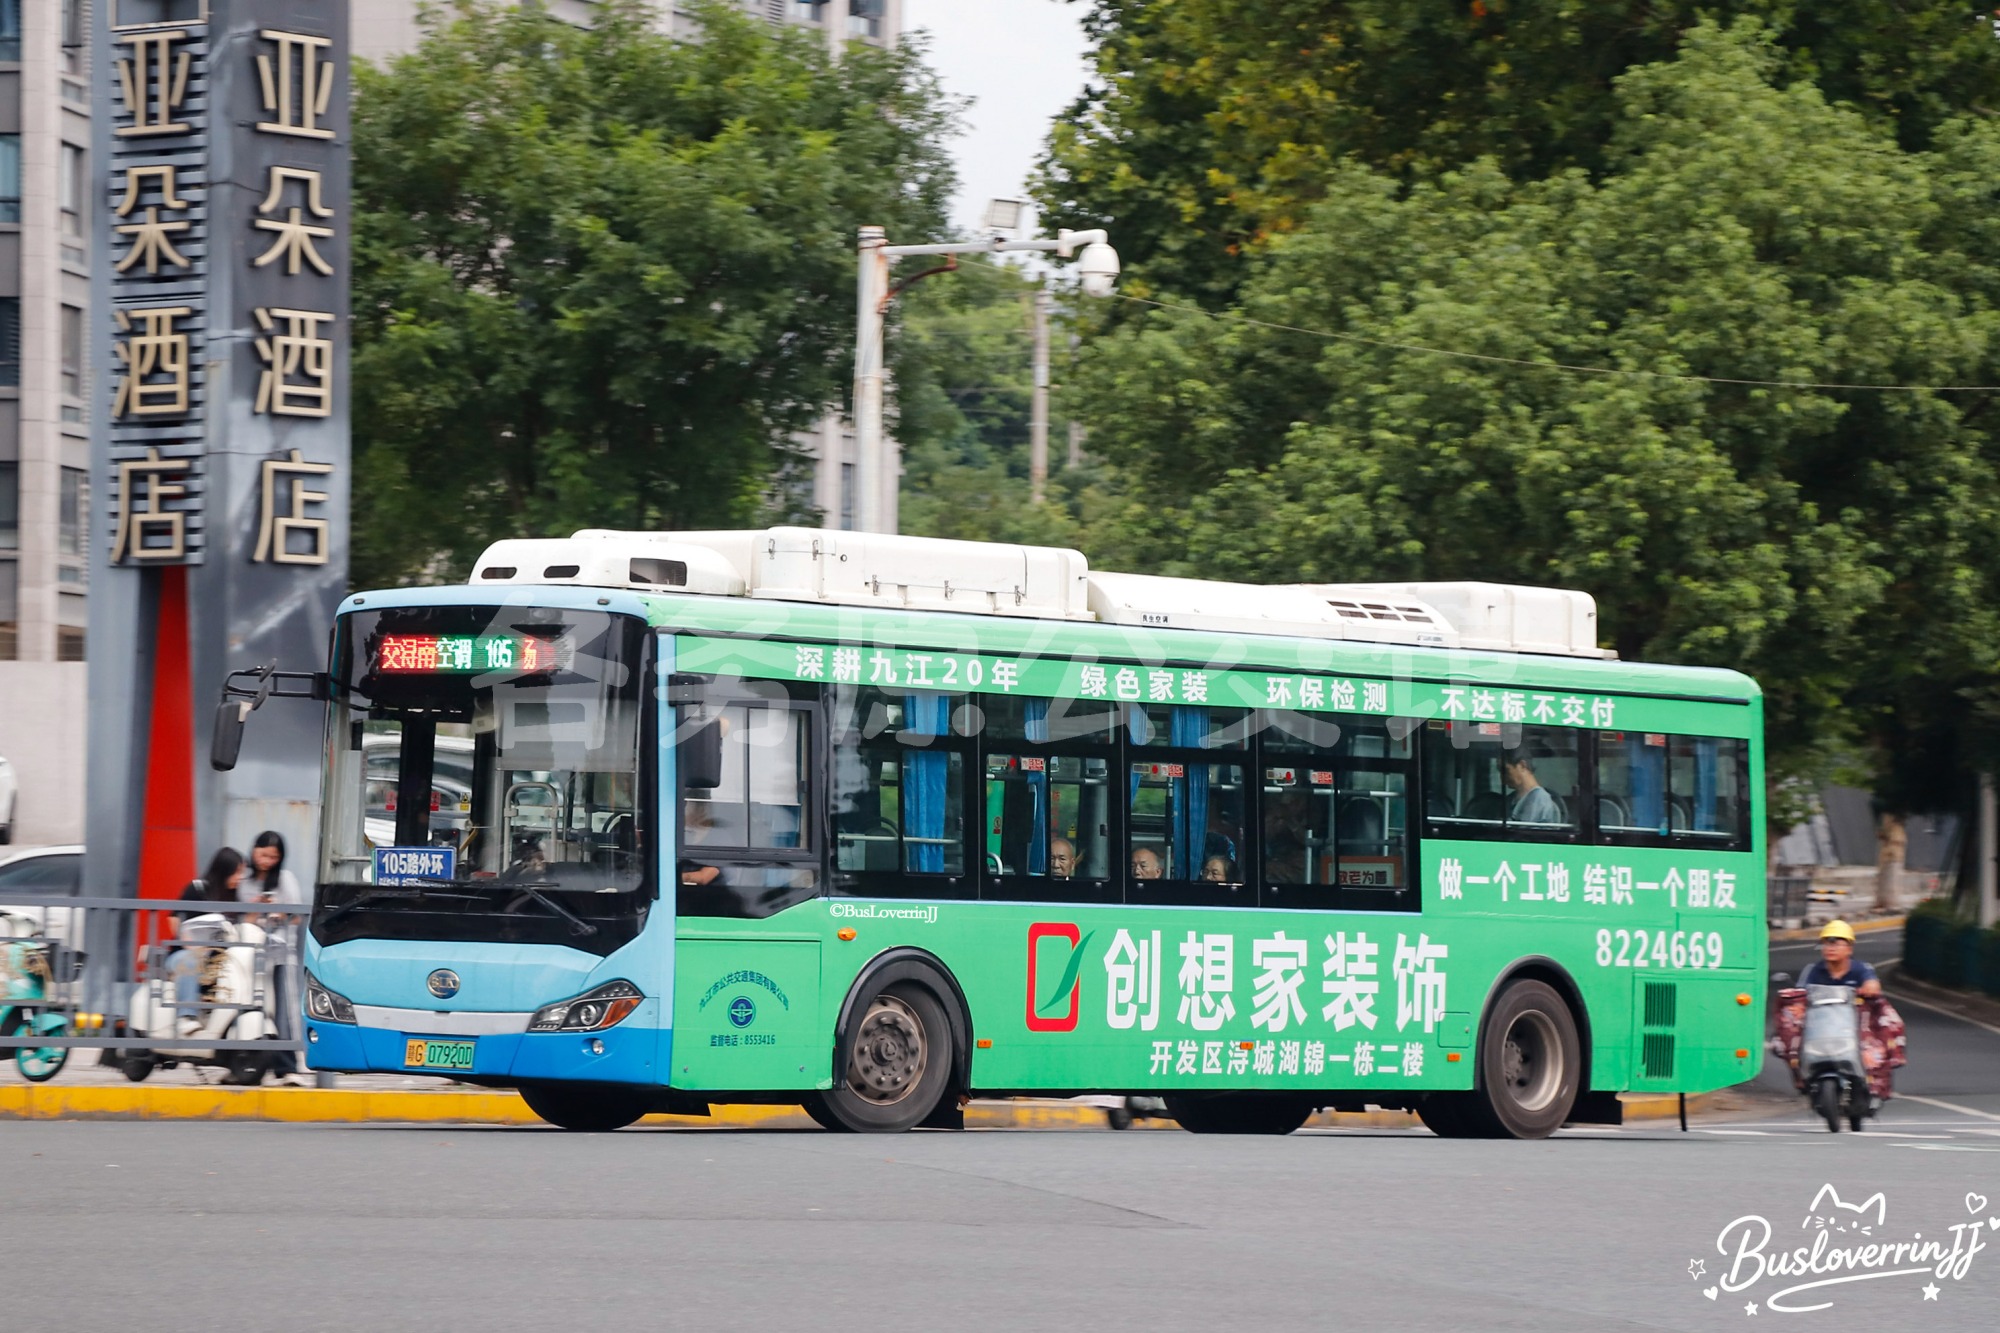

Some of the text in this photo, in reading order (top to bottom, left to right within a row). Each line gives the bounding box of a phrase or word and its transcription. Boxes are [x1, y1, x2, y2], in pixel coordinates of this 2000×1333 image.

[111, 30, 191, 564] 亚朵酒店
[253, 29, 336, 567] 亚朵酒店
[485, 638, 513, 669] 105
[795, 644, 1616, 728] 深耕九江20年 绿色家装 环保检测 不达标不交付
[382, 852, 444, 876] 105路外环
[1438, 858, 1738, 909] 做一个工地 结识一个朋友
[1595, 928, 1724, 970] 8224669
[1103, 928, 1450, 1034] 创想家装饰
[1149, 1040, 1424, 1077] 开发区浔城湖锦一栋二楼
